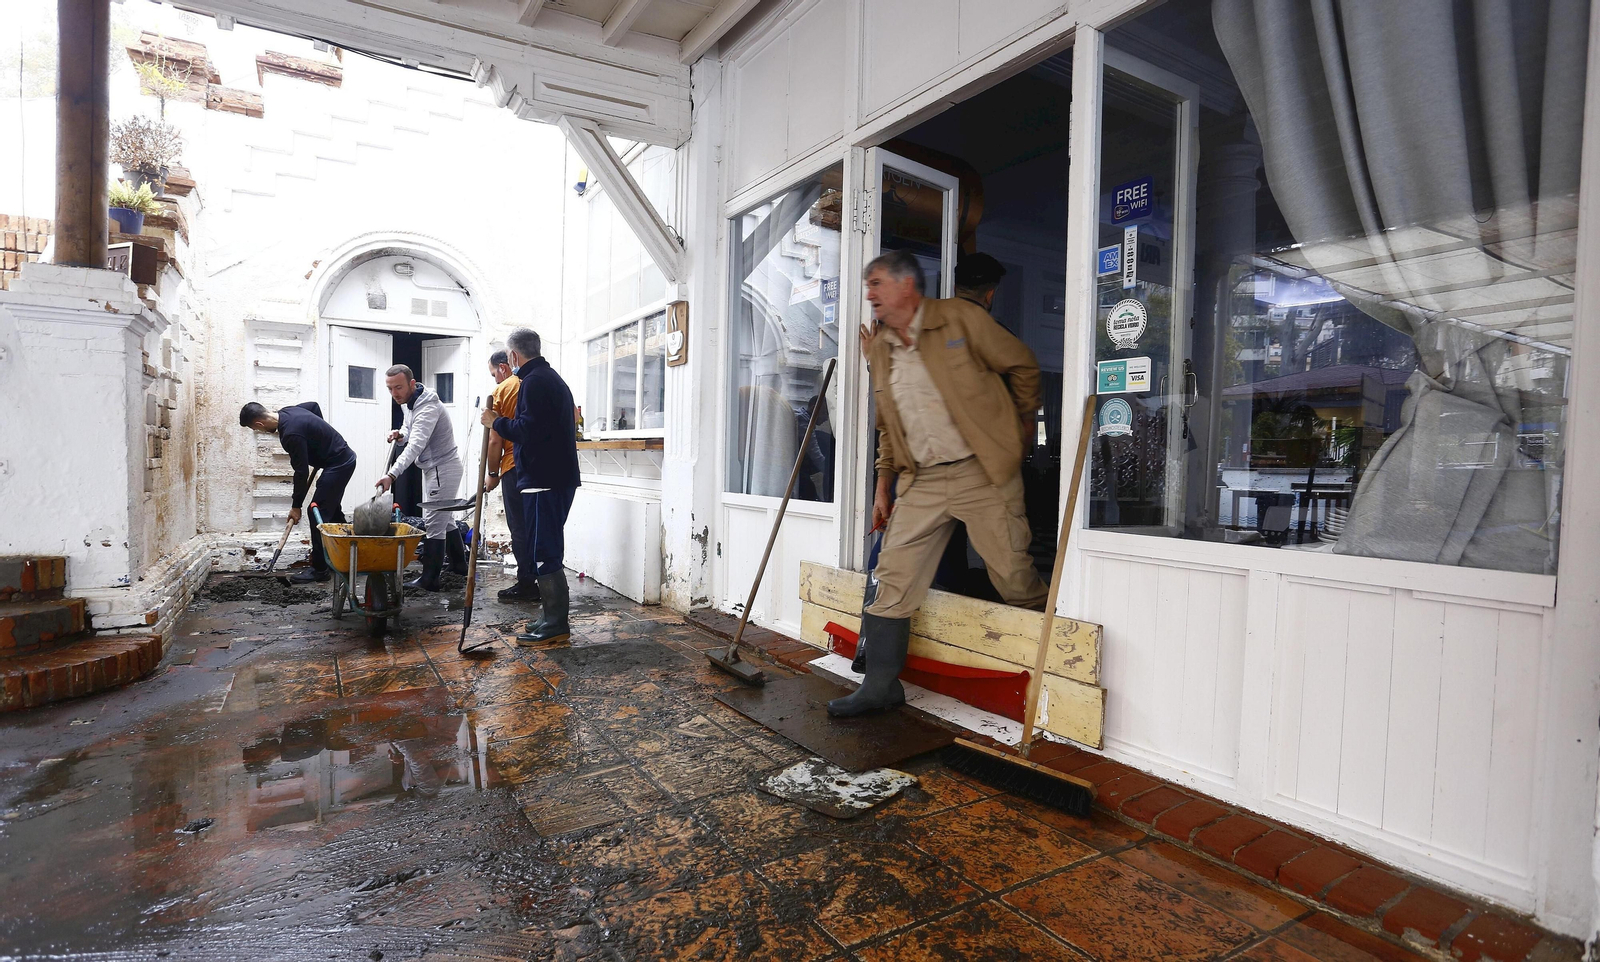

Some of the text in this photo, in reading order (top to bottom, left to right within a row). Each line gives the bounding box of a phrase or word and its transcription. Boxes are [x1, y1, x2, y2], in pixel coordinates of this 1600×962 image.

[1117, 183, 1148, 204] FREE
[1130, 198, 1148, 210] WIFI
[1104, 250, 1118, 261] AM
[1104, 259, 1118, 270] EX
[823, 281, 837, 292] FREE
[1130, 374, 1145, 382] VISA
